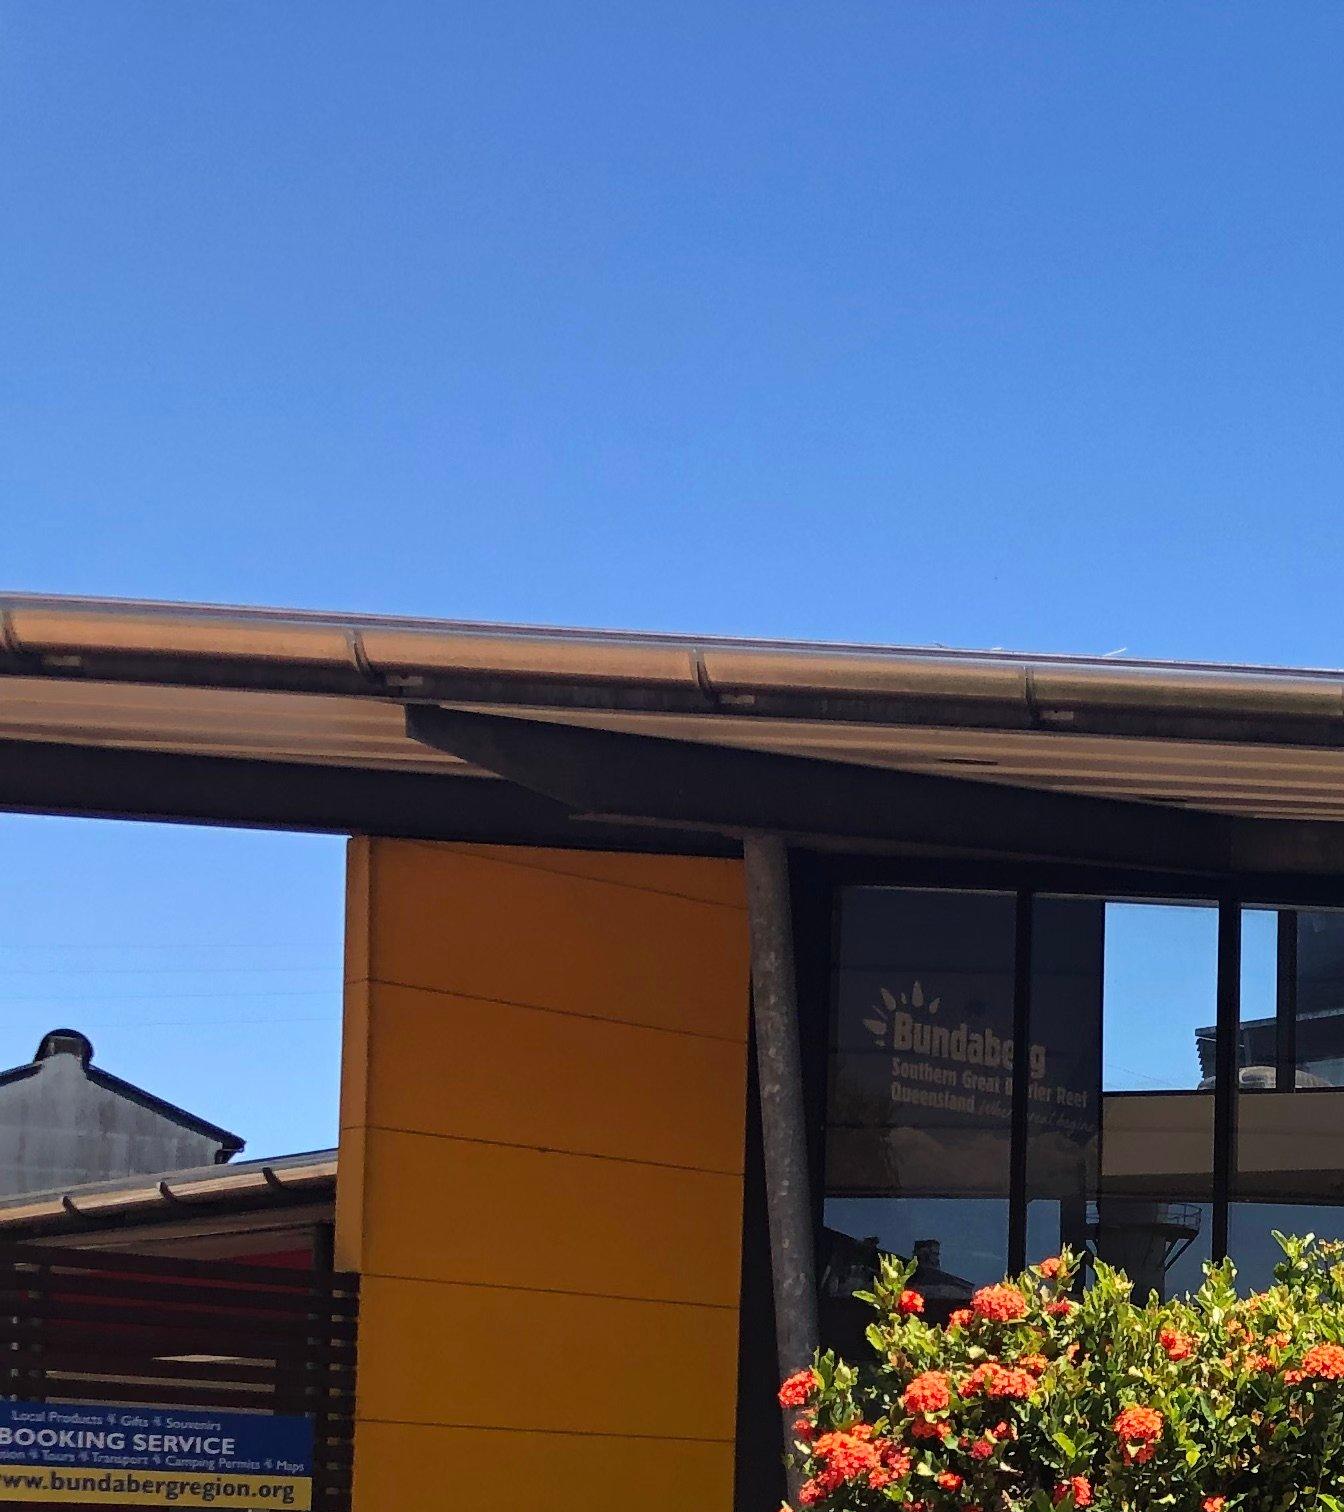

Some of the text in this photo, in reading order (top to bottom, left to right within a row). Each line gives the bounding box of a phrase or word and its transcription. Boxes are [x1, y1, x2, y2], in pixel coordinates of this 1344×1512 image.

[892, 1011, 1046, 1079] Bundabeg
[0, 1427, 236, 1455] BOOKING SERVICE
[0, 1471, 295, 1504] ww.bundabergregion.org
